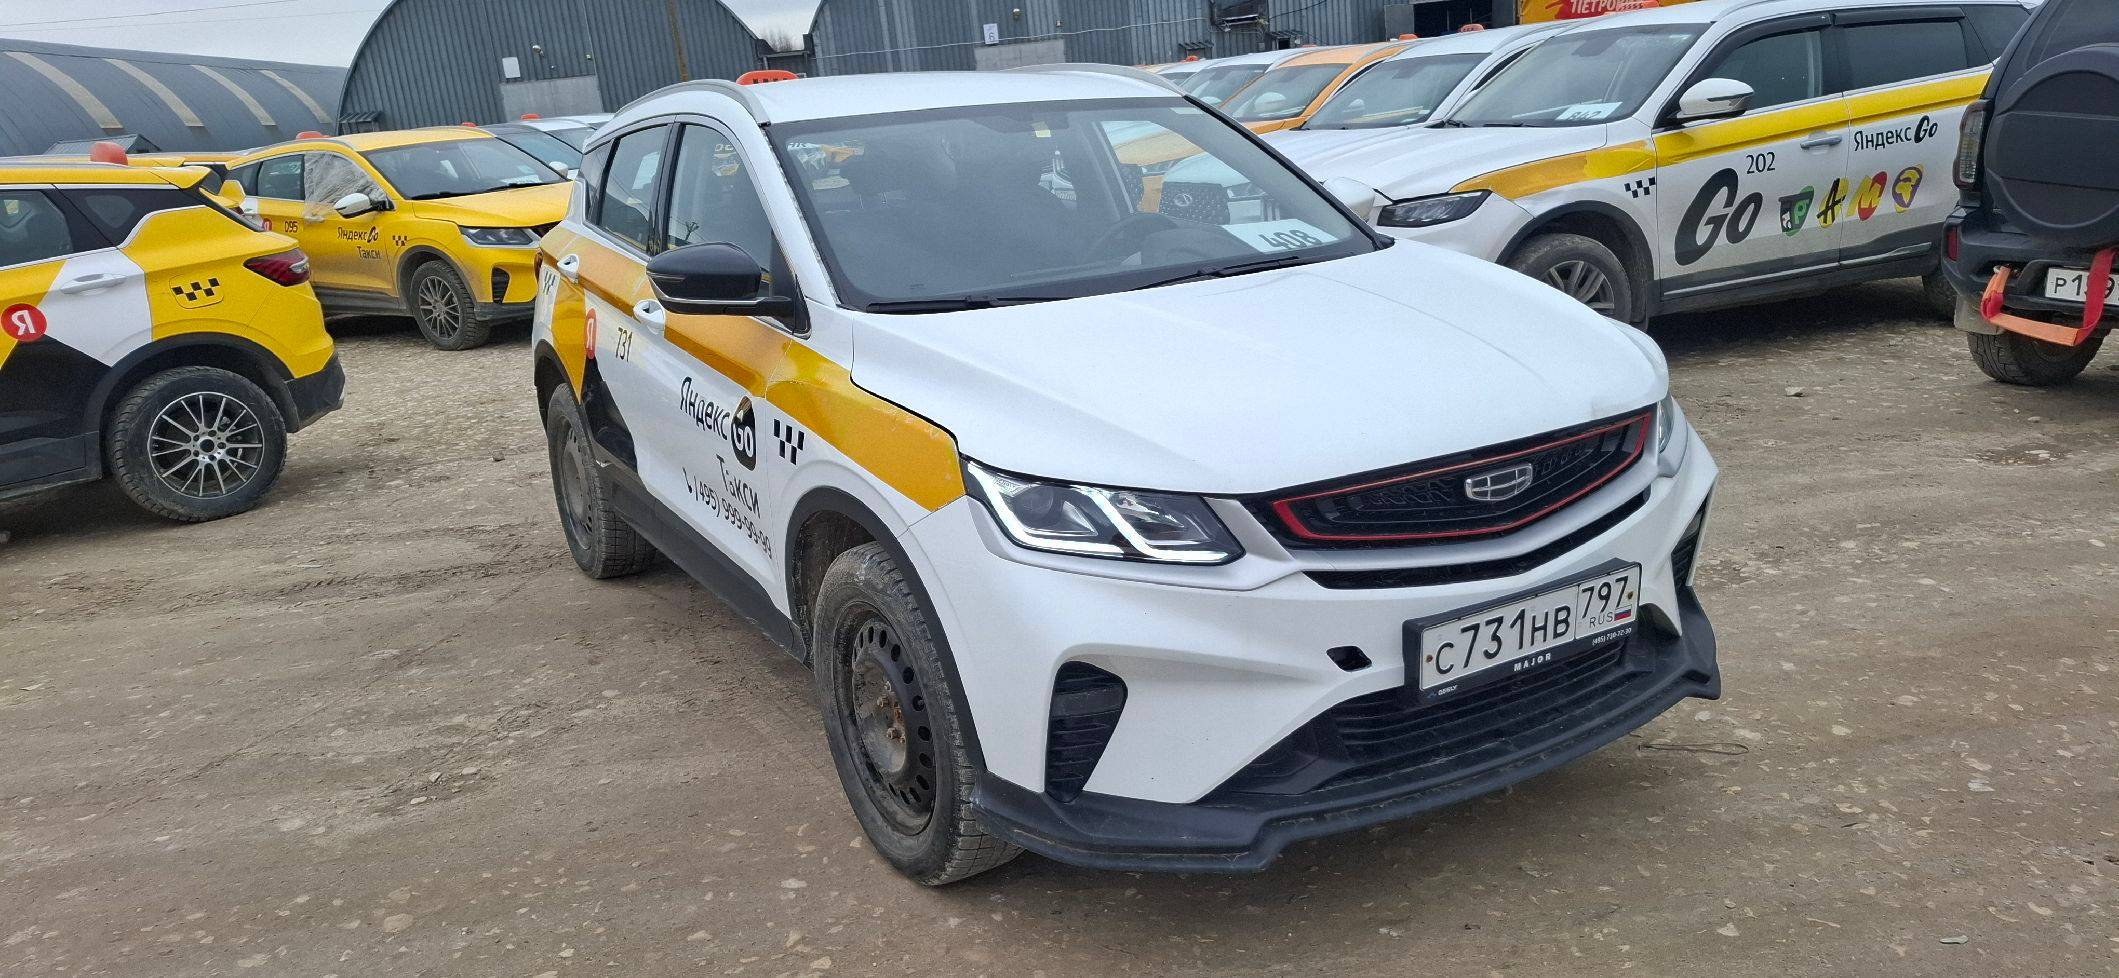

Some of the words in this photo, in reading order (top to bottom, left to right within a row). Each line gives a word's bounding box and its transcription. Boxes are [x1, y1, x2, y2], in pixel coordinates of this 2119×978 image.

[1853, 126, 1912, 151] Яндекс
[1913, 115, 1939, 144] Go
[1745, 151, 1776, 175] 202
[284, 220, 298, 233] 095
[337, 226, 367, 240] Яндекс
[1674, 167, 1764, 266] Go
[357, 246, 382, 259] Такси
[1258, 229, 1322, 250] 408
[615, 326, 632, 362] 731
[680, 376, 730, 440] Яндекс
[716, 453, 760, 519] Такси
[694, 475, 720, 517] (495)
[722, 497, 772, 560] 999-99-99
[1581, 575, 1629, 619] 797
[1589, 611, 1613, 628] RUS
[1434, 604, 1571, 675] С731НВ
[1513, 652, 1552, 673] MAJOR
